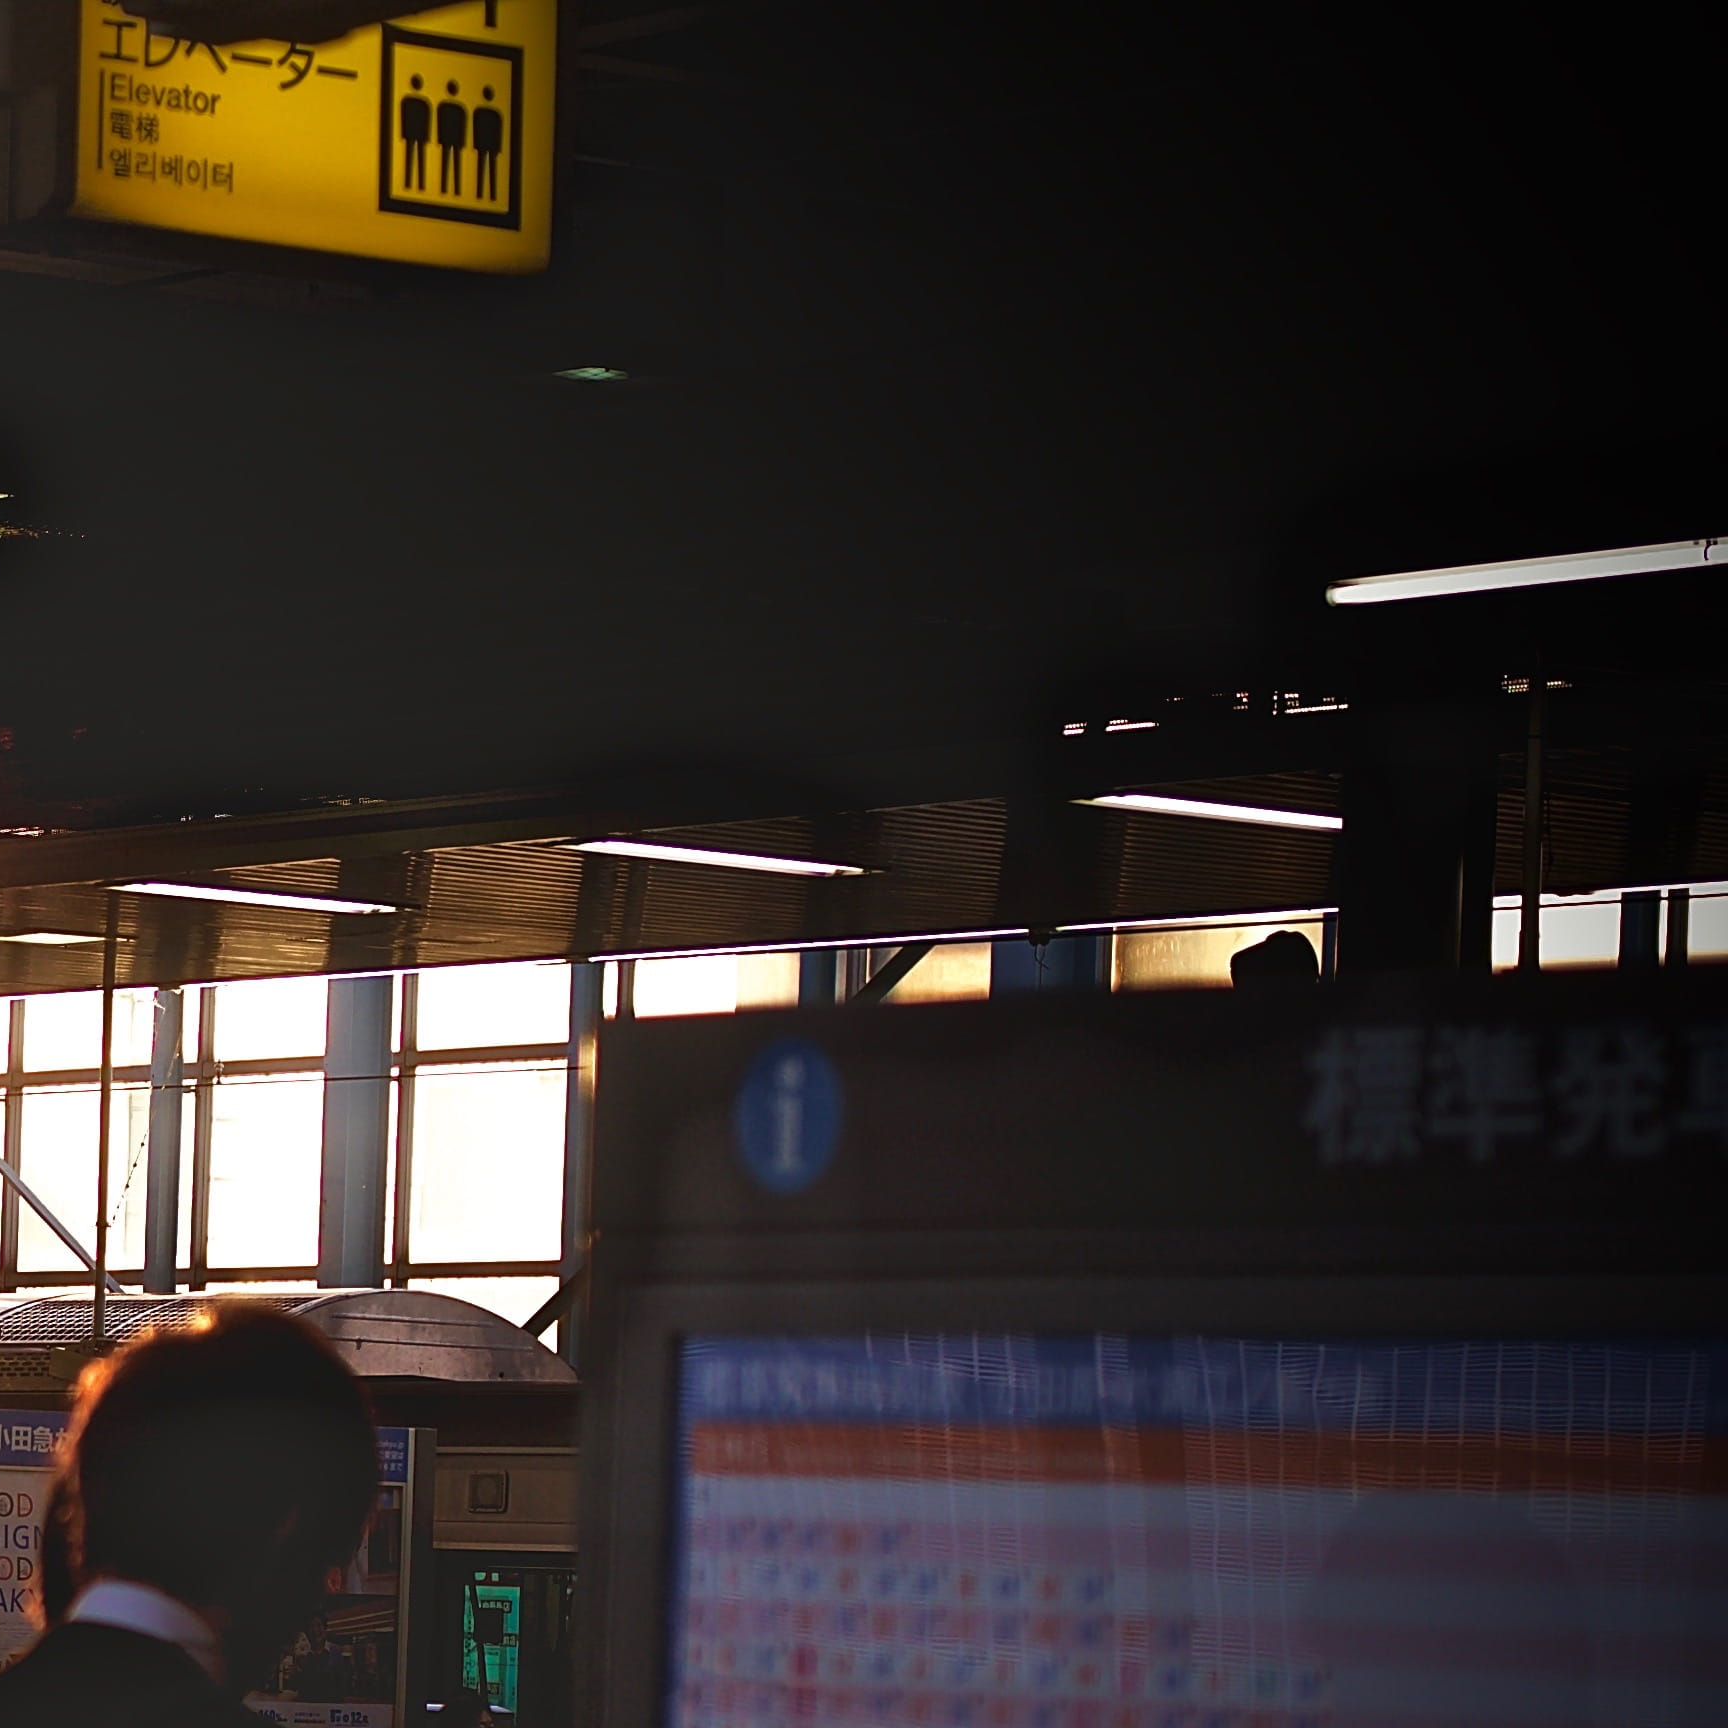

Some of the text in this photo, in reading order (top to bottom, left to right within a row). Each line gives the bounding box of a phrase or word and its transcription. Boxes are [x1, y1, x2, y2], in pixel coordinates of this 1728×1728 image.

[110, 73, 221, 115] Elevator
[111, 109, 159, 143] 電梯
[110, 148, 234, 194] 엘리베이터
